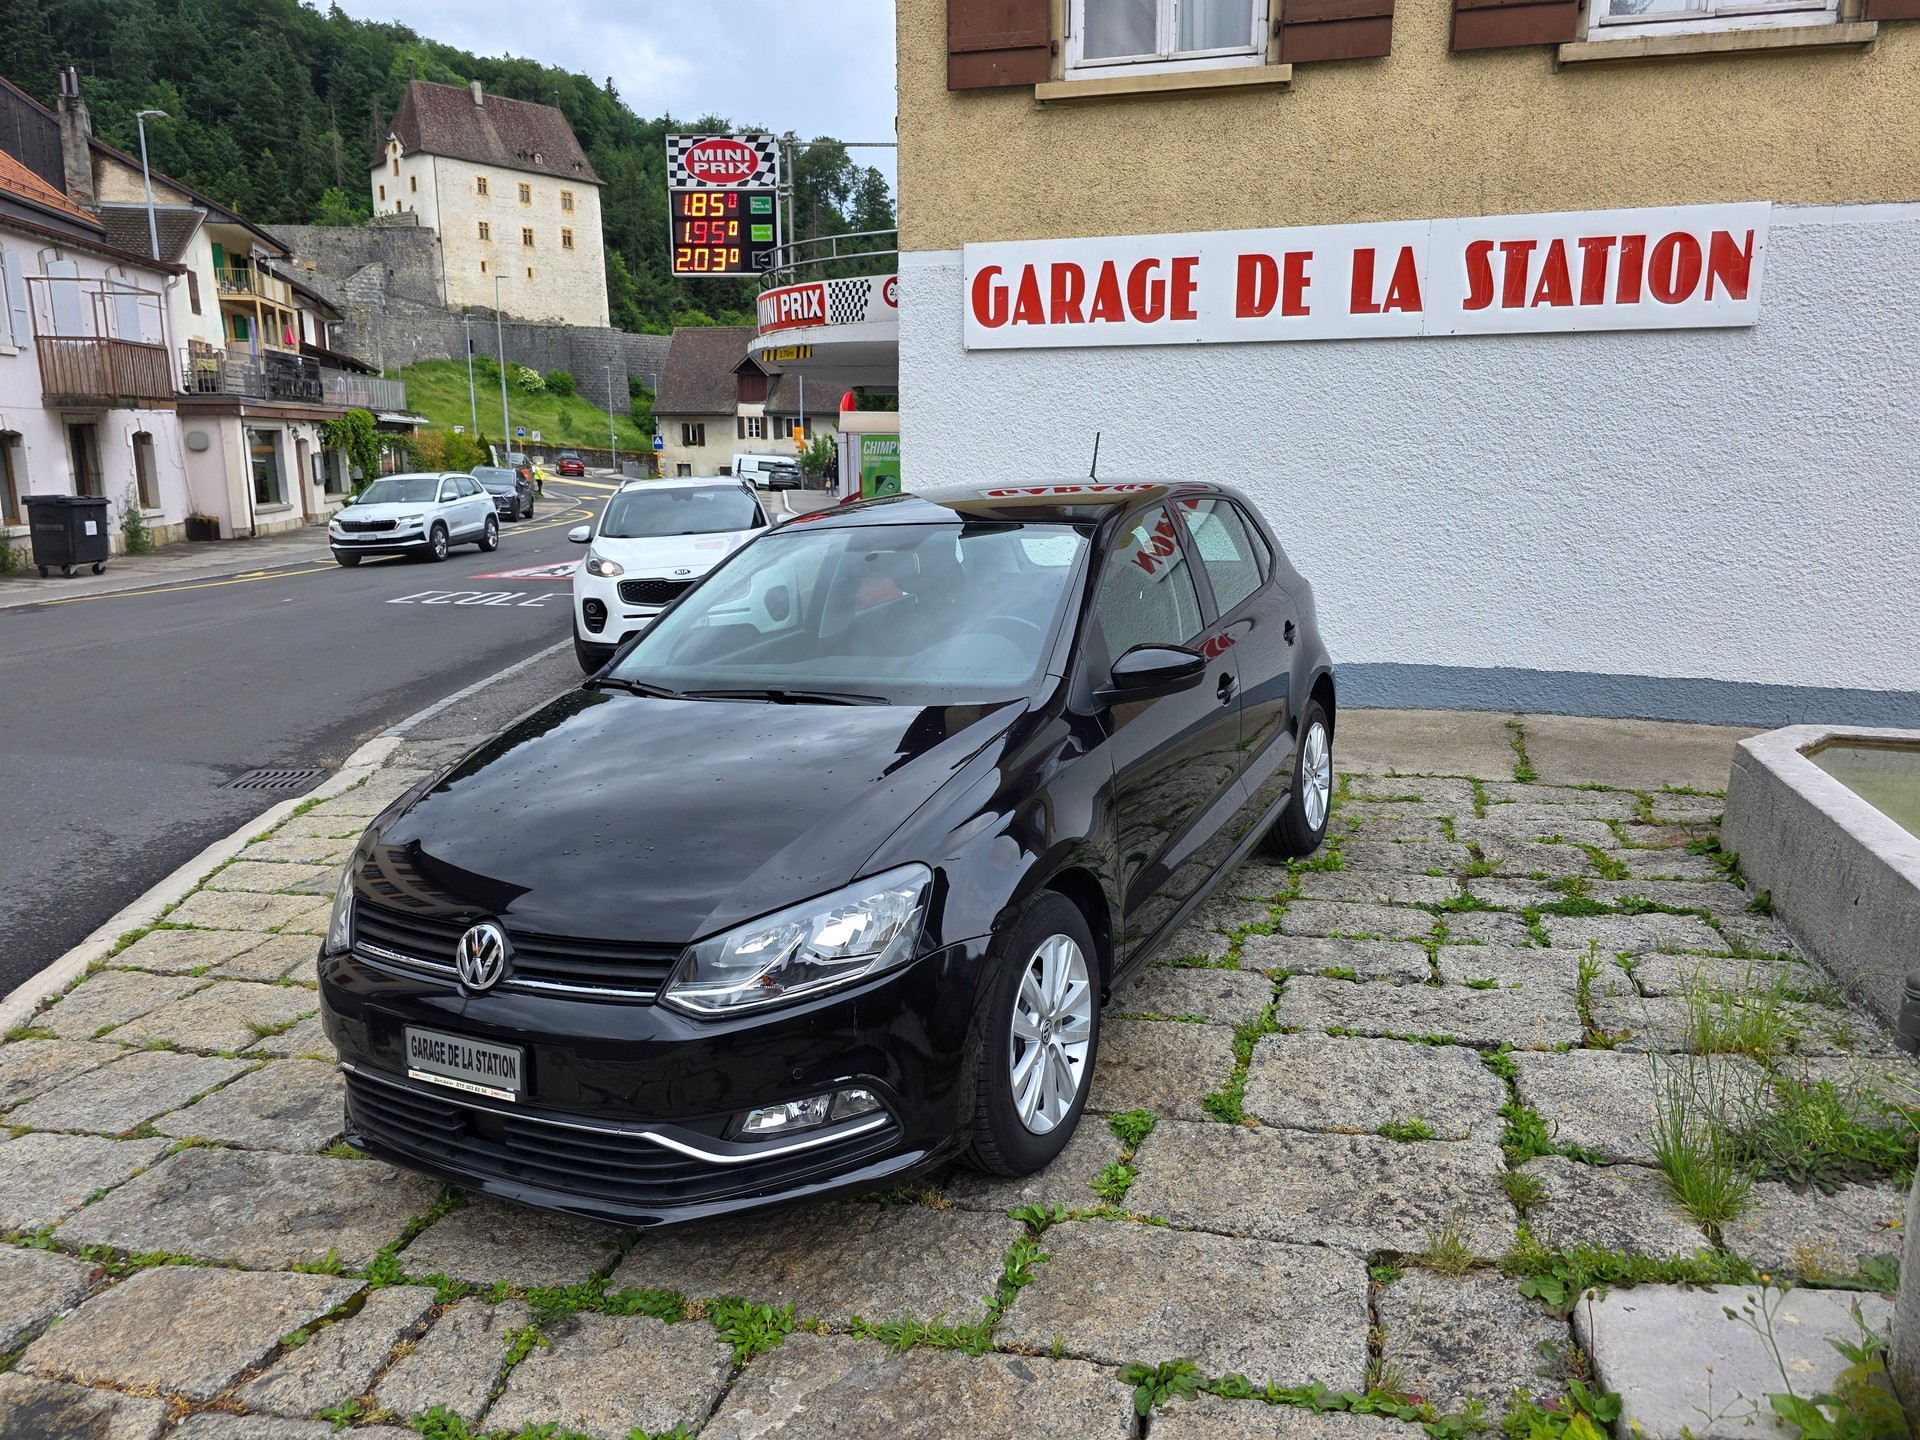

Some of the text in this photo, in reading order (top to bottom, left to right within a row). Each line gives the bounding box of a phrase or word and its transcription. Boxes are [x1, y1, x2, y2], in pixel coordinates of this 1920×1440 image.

[693, 149, 751, 161] MINI
[693, 162, 751, 174] PRIX
[971, 229, 1755, 329] GARAGE DE LA STATION
[780, 289, 823, 323] PRIX
[385, 590, 575, 607] ECOLE
[411, 1035, 516, 1080] GARAGE DE LA STATION
